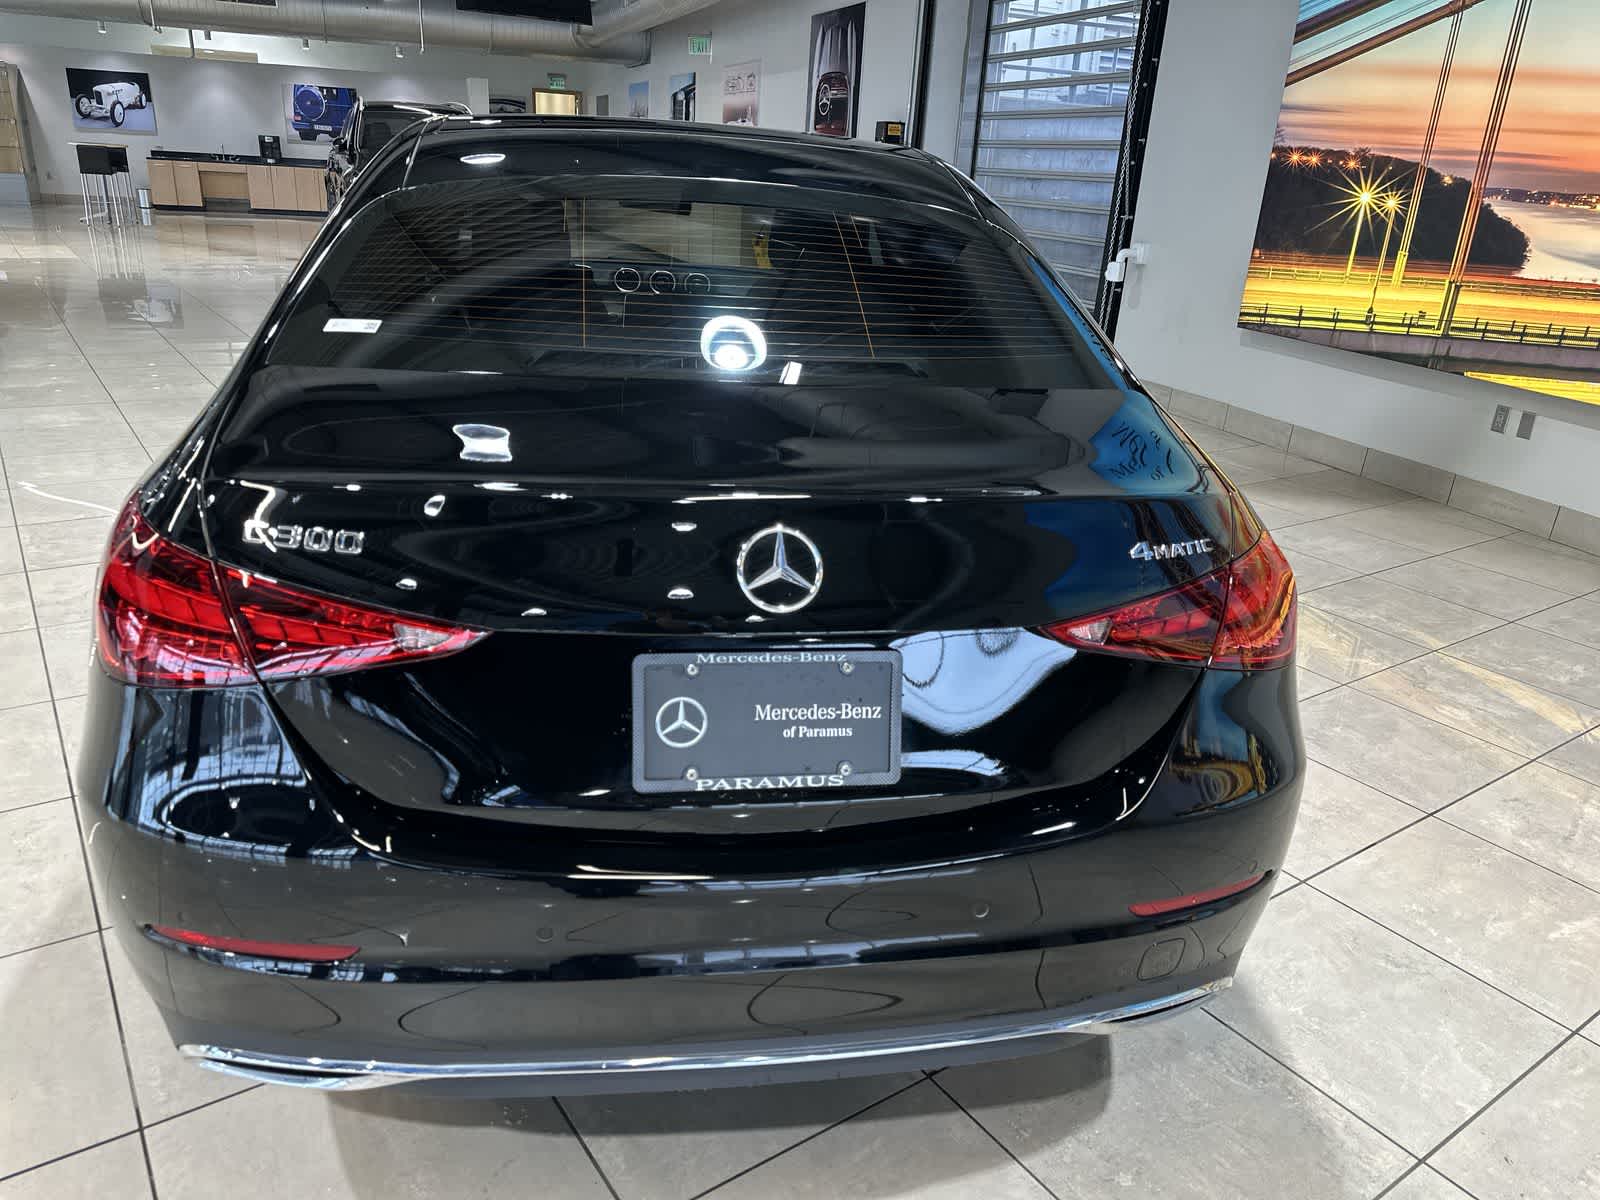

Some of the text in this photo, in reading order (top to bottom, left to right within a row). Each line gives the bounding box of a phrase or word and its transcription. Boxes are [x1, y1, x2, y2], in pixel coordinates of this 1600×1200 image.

[1129, 539, 1213, 560] 4MATIC
[696, 652, 847, 664] Mercedes-Benz
[754, 703, 882, 721] Mercedes-Benz
[782, 726, 853, 738] of Paramus
[695, 775, 845, 791] PARAMUS
